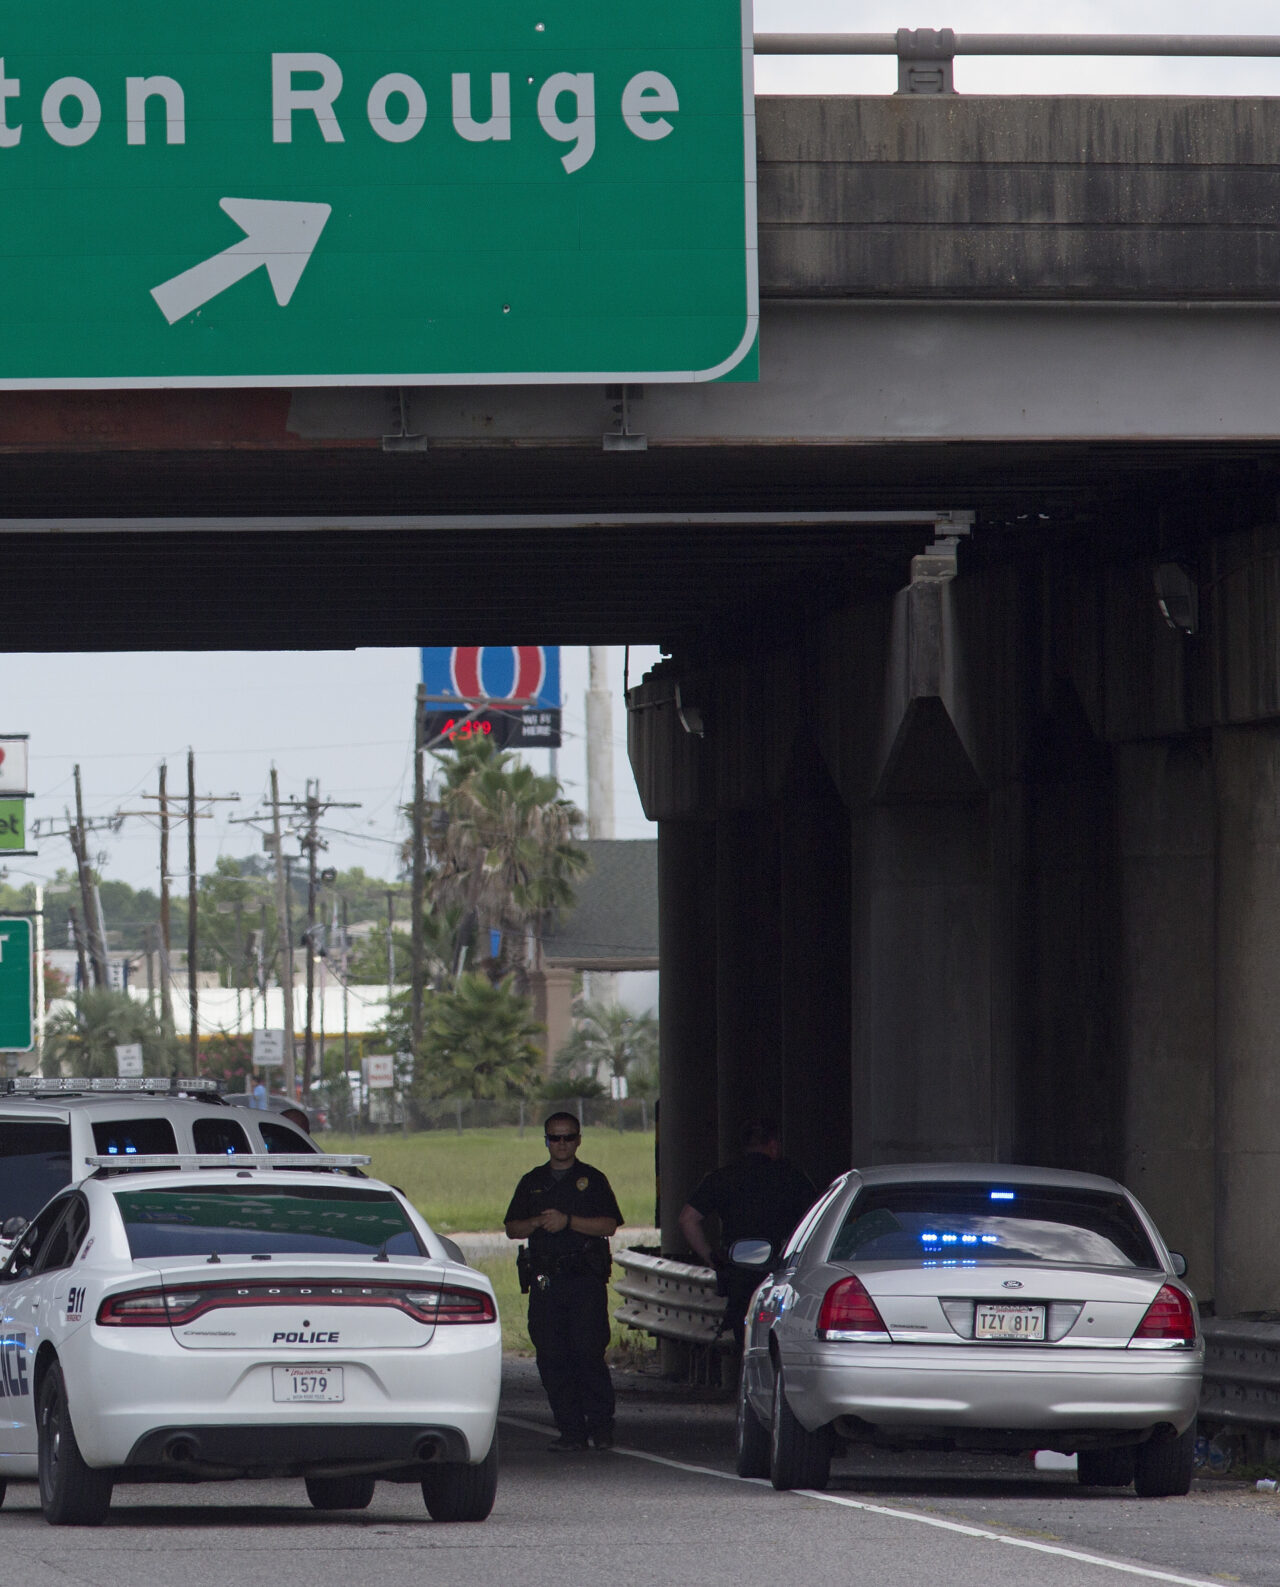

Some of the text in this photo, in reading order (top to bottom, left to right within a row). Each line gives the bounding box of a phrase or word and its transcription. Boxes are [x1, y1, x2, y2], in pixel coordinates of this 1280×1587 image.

[271, 52, 681, 175] Rouge
[67, 1286, 87, 1313] 911
[980, 1313, 1040, 1331] TZY 817
[272, 1331, 340, 1344] POLICE
[293, 1376, 328, 1393] 1579
